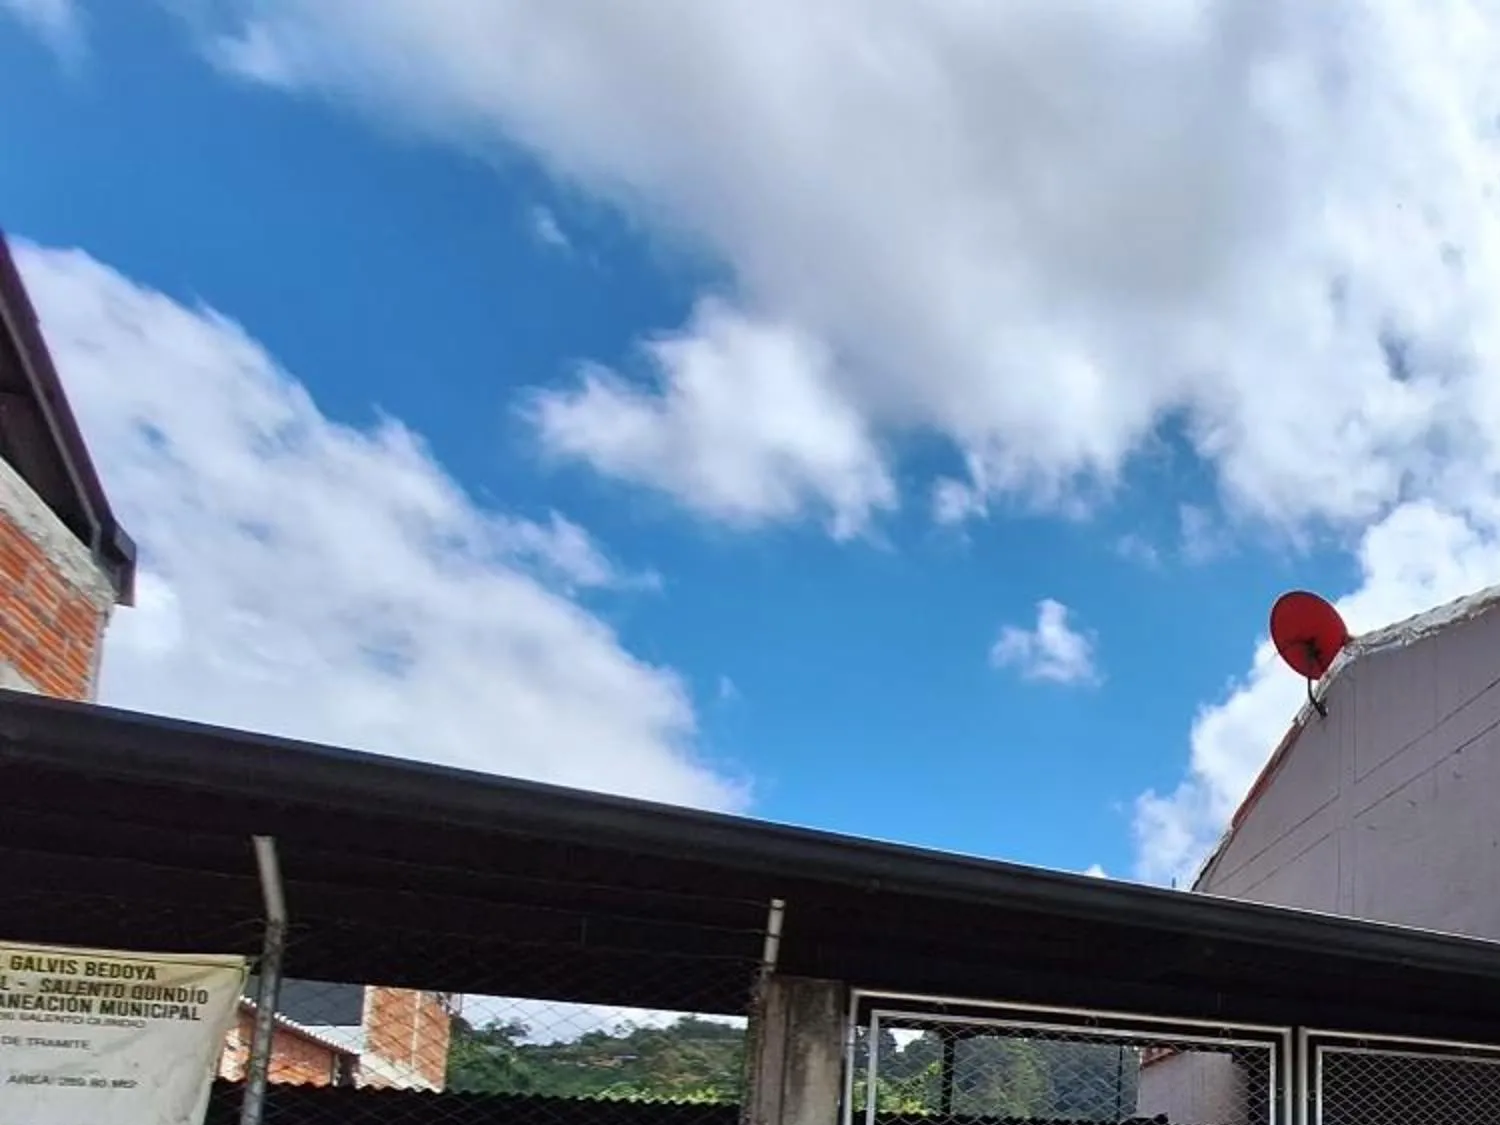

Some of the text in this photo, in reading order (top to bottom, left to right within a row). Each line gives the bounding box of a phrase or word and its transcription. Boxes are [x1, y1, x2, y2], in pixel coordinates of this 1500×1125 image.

[10, 955, 156, 981] GALVIS BEDOYA
[39, 978, 125, 999] SALENTO
[99, 999, 201, 1021] MUNICIPAL
